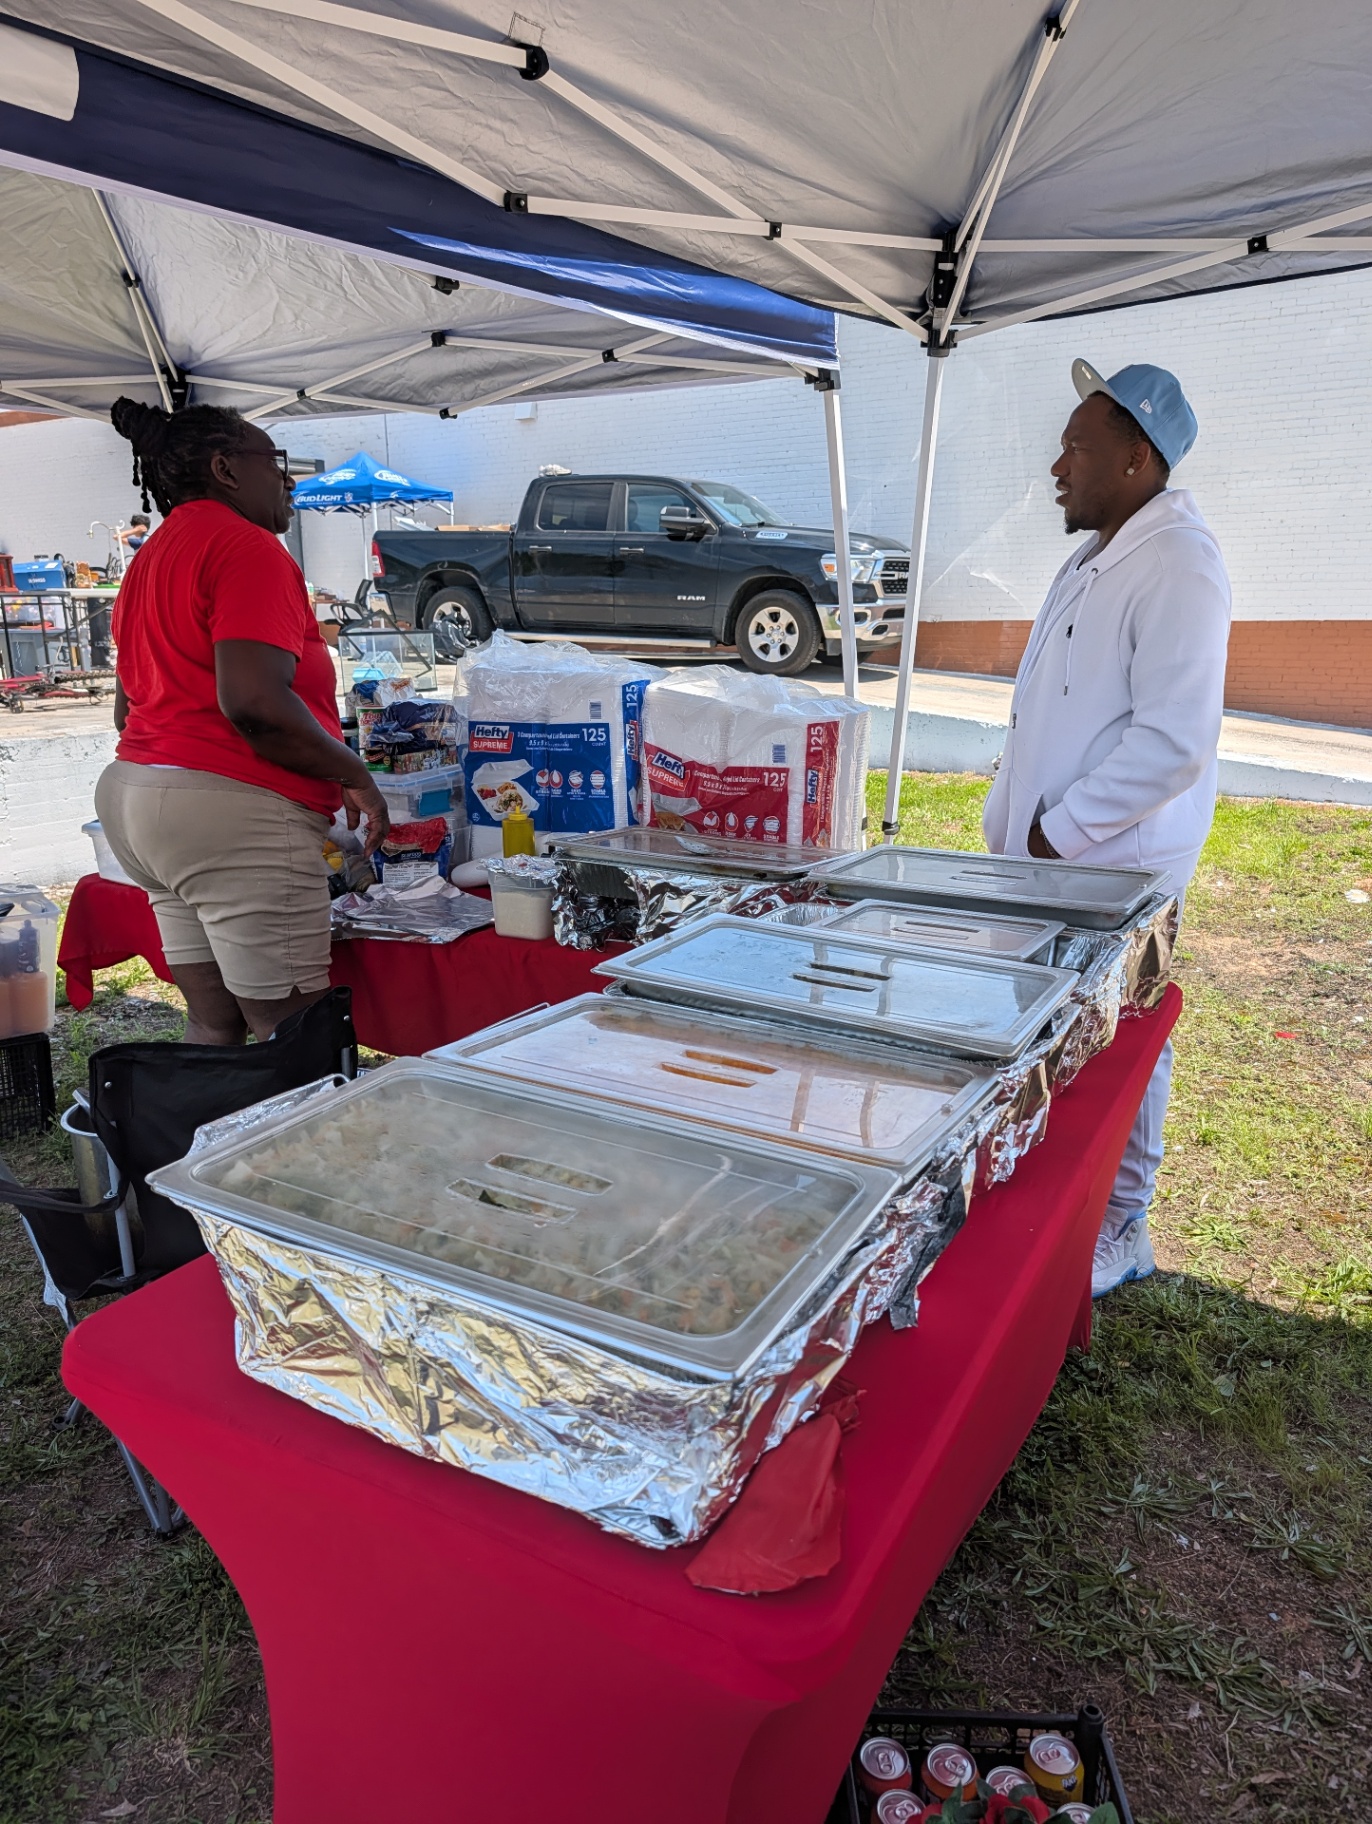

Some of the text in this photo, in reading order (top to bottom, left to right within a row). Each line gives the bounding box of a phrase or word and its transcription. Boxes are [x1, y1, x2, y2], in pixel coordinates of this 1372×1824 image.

[316, 494, 343, 502] LIGHT
[677, 594, 706, 602] RAM
[626, 684, 638, 708] 125
[475, 726, 508, 739] Hefty
[582, 728, 607, 742] 125
[627, 724, 637, 754] Hefty
[811, 726, 824, 752] 125
[473, 740, 509, 750] SUPREME
[763, 772, 787, 787] 125
[808, 770, 818, 803] Hefty
